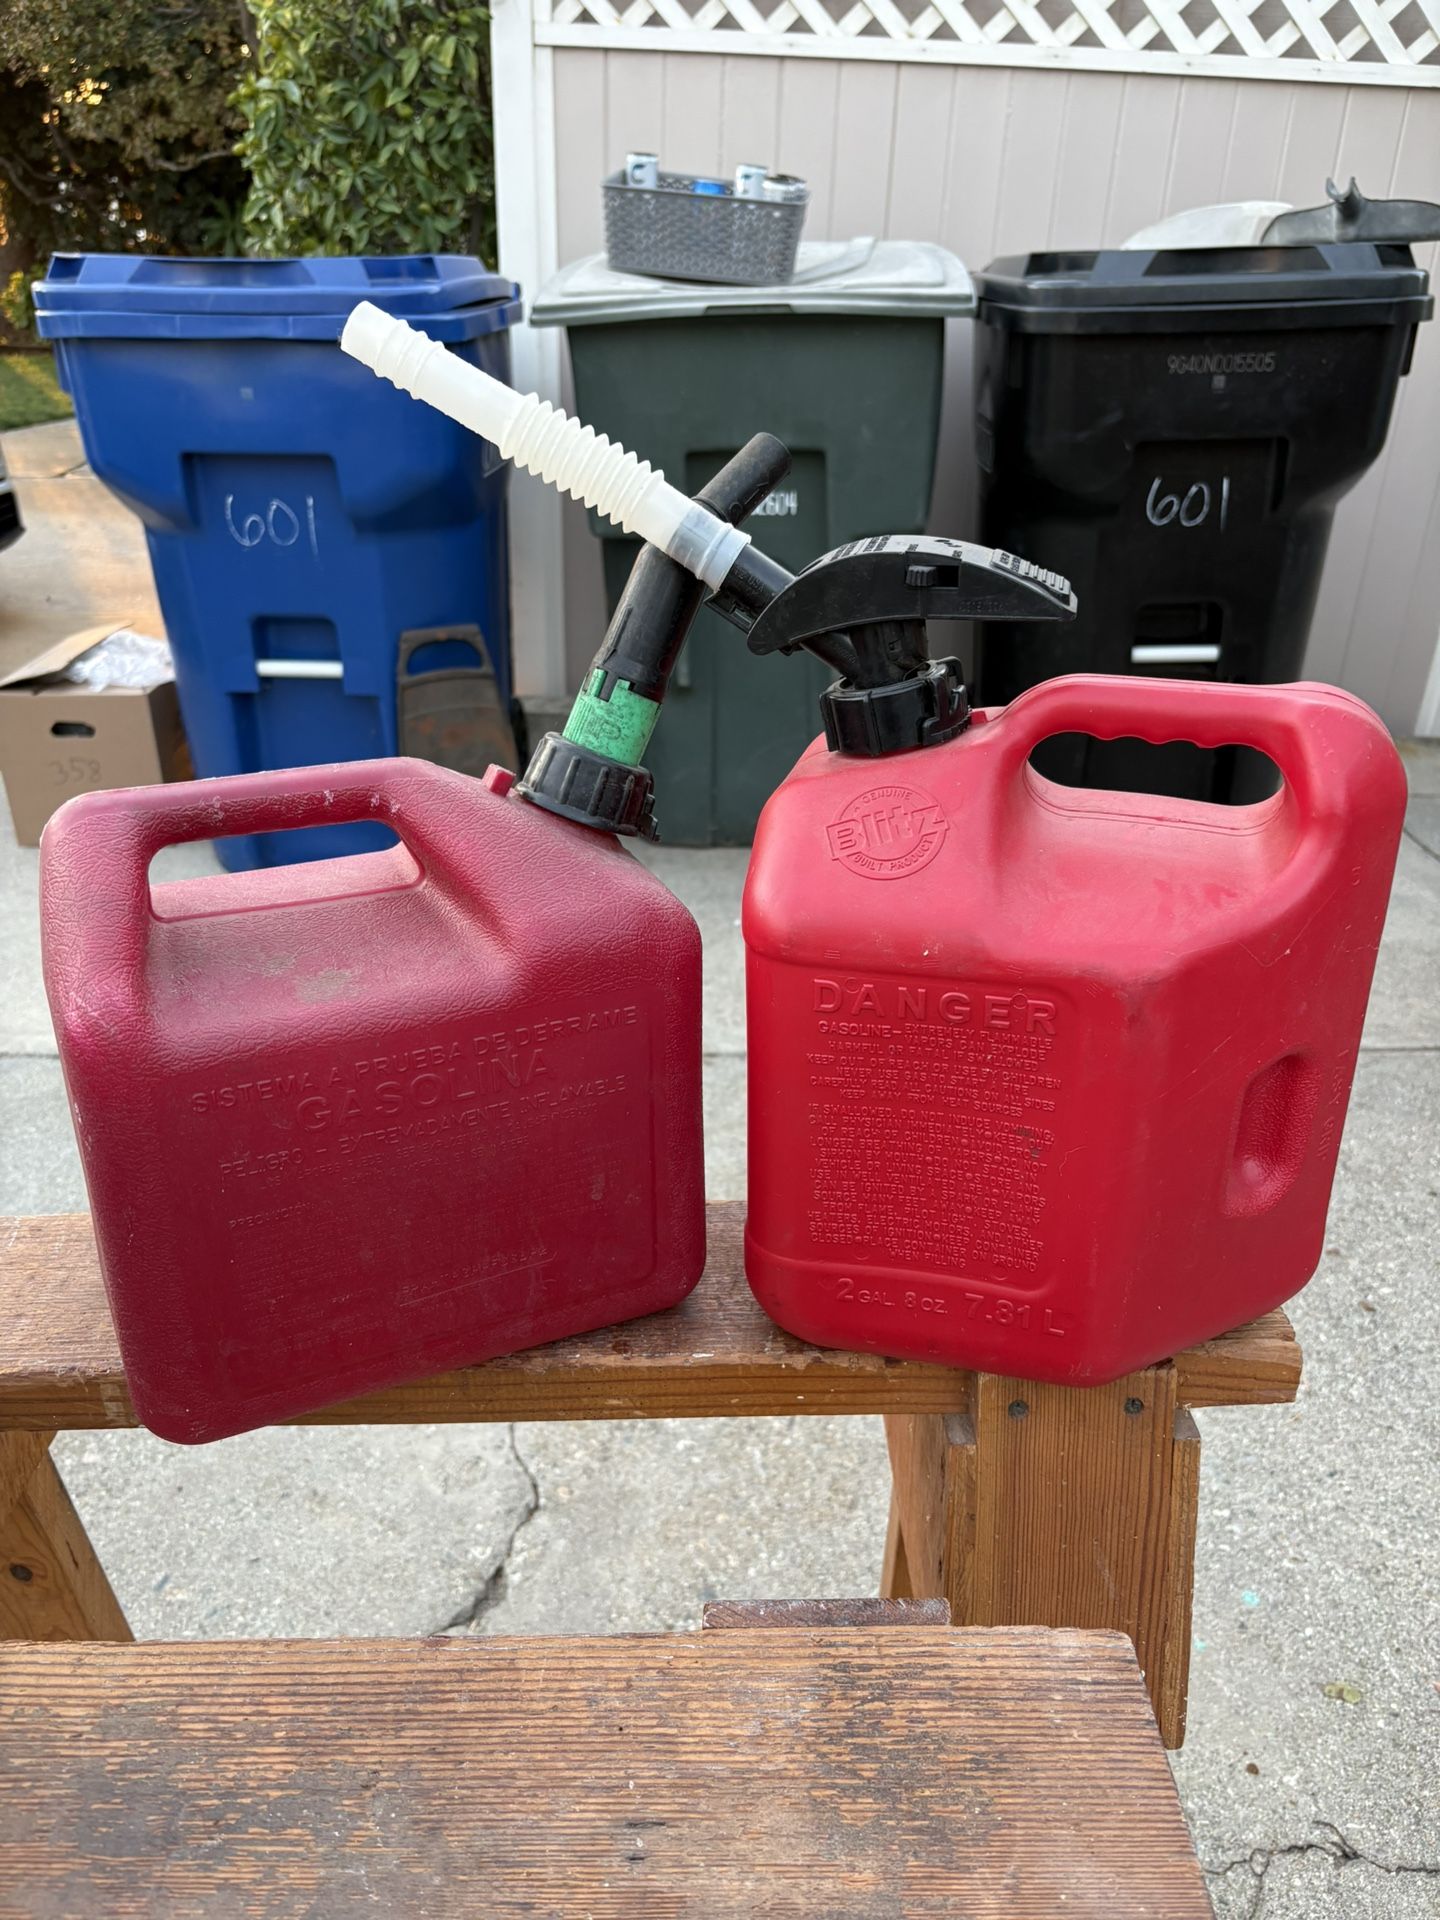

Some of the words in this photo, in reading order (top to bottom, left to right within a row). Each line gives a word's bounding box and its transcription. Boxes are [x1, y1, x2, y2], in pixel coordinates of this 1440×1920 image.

[1146, 475, 1230, 534] 601
[224, 493, 319, 561] 601
[47, 756, 102, 785] 358
[861, 789, 913, 803] GENUINE
[854, 854, 884, 870] BUILT
[889, 837, 933, 870] PRODUCT
[809, 978, 1057, 1036] DANGER
[904, 1022, 973, 1039] EXTREMELY
[978, 1030, 1050, 1049] FLAMMABLE
[904, 1034, 952, 1048] VAPORS
[960, 1039, 986, 1052] CAN
[991, 1043, 1046, 1061] EXPLODE
[191, 1071, 316, 1116] SISTEMA
[329, 1066, 342, 1085] A
[355, 1042, 463, 1079] PRUEBA
[472, 1031, 507, 1055] DE
[515, 1004, 638, 1047] DERRAME
[805, 1052, 834, 1064] KEEP
[840, 1054, 864, 1066] OUT
[870, 1057, 885, 1067] OF
[888, 1058, 929, 1072] REACH
[932, 1062, 948, 1074] OR
[952, 1065, 977, 1077] USE
[980, 1068, 998, 1080] BY
[1001, 1070, 1061, 1090] CHILDREN
[828, 1039, 883, 1053] HARMFUL
[888, 1043, 902, 1054] OR
[908, 1045, 949, 1059] FATAL
[967, 1051, 1038, 1071] SWALLOWED
[298, 1047, 549, 1132] GASOLINA
[810, 1076, 867, 1088] CAREFULLY
[871, 1079, 896, 1090] READ
[902, 1081, 920, 1093] ALL
[924, 1083, 979, 1100] CAUTIONS
[984, 1090, 999, 1102] ON
[1004, 1093, 1021, 1106] ALL
[1023, 1095, 1055, 1112] SIDES
[835, 1066, 871, 1078] NEVER
[877, 1068, 898, 1079] USE
[904, 1070, 926, 1082] GAS
[930, 1072, 945, 1084] TO
[950, 1074, 987, 1089] START
[1001, 1081, 1029, 1096] FIRE
[808, 1102, 819, 1112] IF
[900, 1108, 915, 1119] DO
[920, 1110, 944, 1123] NOT
[948, 1113, 990, 1129] INDUCE
[839, 1087, 865, 1098] KEEP
[870, 1089, 900, 1101] AWAY
[906, 1092, 936, 1105] FROM
[941, 1096, 969, 1109] HEAT
[973, 1100, 1022, 1118] SOURCES
[338, 1101, 511, 1155] EXTREMADAMENTE
[808, 1113, 837, 1124] CALL
[842, 1115, 900, 1129] PHYSICIAN
[1029, 1136, 1054, 1152] OUT
[821, 1125, 836, 1136] OF
[841, 1126, 881, 1138] REACH
[884, 1128, 899, 1140] OF
[810, 1135, 853, 1147] LONGED
[859, 1137, 922, 1153] BREATHING
[927, 1144, 942, 1155] OF
[1024, 1158, 1048, 1173] NOT
[820, 1147, 860, 1159] SIPHON
[866, 1149, 880, 1160] BY
[953, 1158, 977, 1172] NOT
[809, 1168, 830, 1178] USE
[851, 1170, 880, 1181] WELL
[885, 1172, 955, 1190] VENTILATED
[815, 1158, 861, 1170] VEHICLE
[866, 1160, 881, 1171] OR
[886, 1161, 921, 1175] LIVING
[1015, 1179, 1040, 1195] AND
[812, 1190, 857, 1201] SOURCE
[861, 1192, 894, 1204] MANY
[898, 1195, 926, 1208] FEET
[1008, 1212, 1040, 1229] AWAY
[814, 1179, 838, 1190] CAN
[841, 1180, 857, 1191] BE
[860, 1181, 904, 1195] IGNITED
[909, 1185, 924, 1197] BY
[940, 1189, 977, 1205] SPARK
[984, 1196, 998, 1209] OR
[1003, 1200, 1040, 1218] FLAME
[823, 1201, 851, 1212] FROM
[904, 1206, 937, 1221] PILOT
[808, 1221, 860, 1234] SOURCES
[865, 1224, 879, 1236] OF
[975, 1238, 1040, 1262] CONTAINER
[866, 1213, 920, 1229] ELECTRIC
[979, 1228, 1000, 1243] AND
[1006, 1233, 1044, 1253] OTHER
[887, 1248, 920, 1261] WHEN
[925, 1252, 967, 1270] FILLING
[903, 1239, 967, 1259] CONTAINER
[972, 1249, 988, 1262] ON
[992, 1252, 1037, 1273] GROUND
[836, 1277, 854, 1300] 2
[903, 1290, 916, 1308] 8
[1043, 1307, 1065, 1336] L
